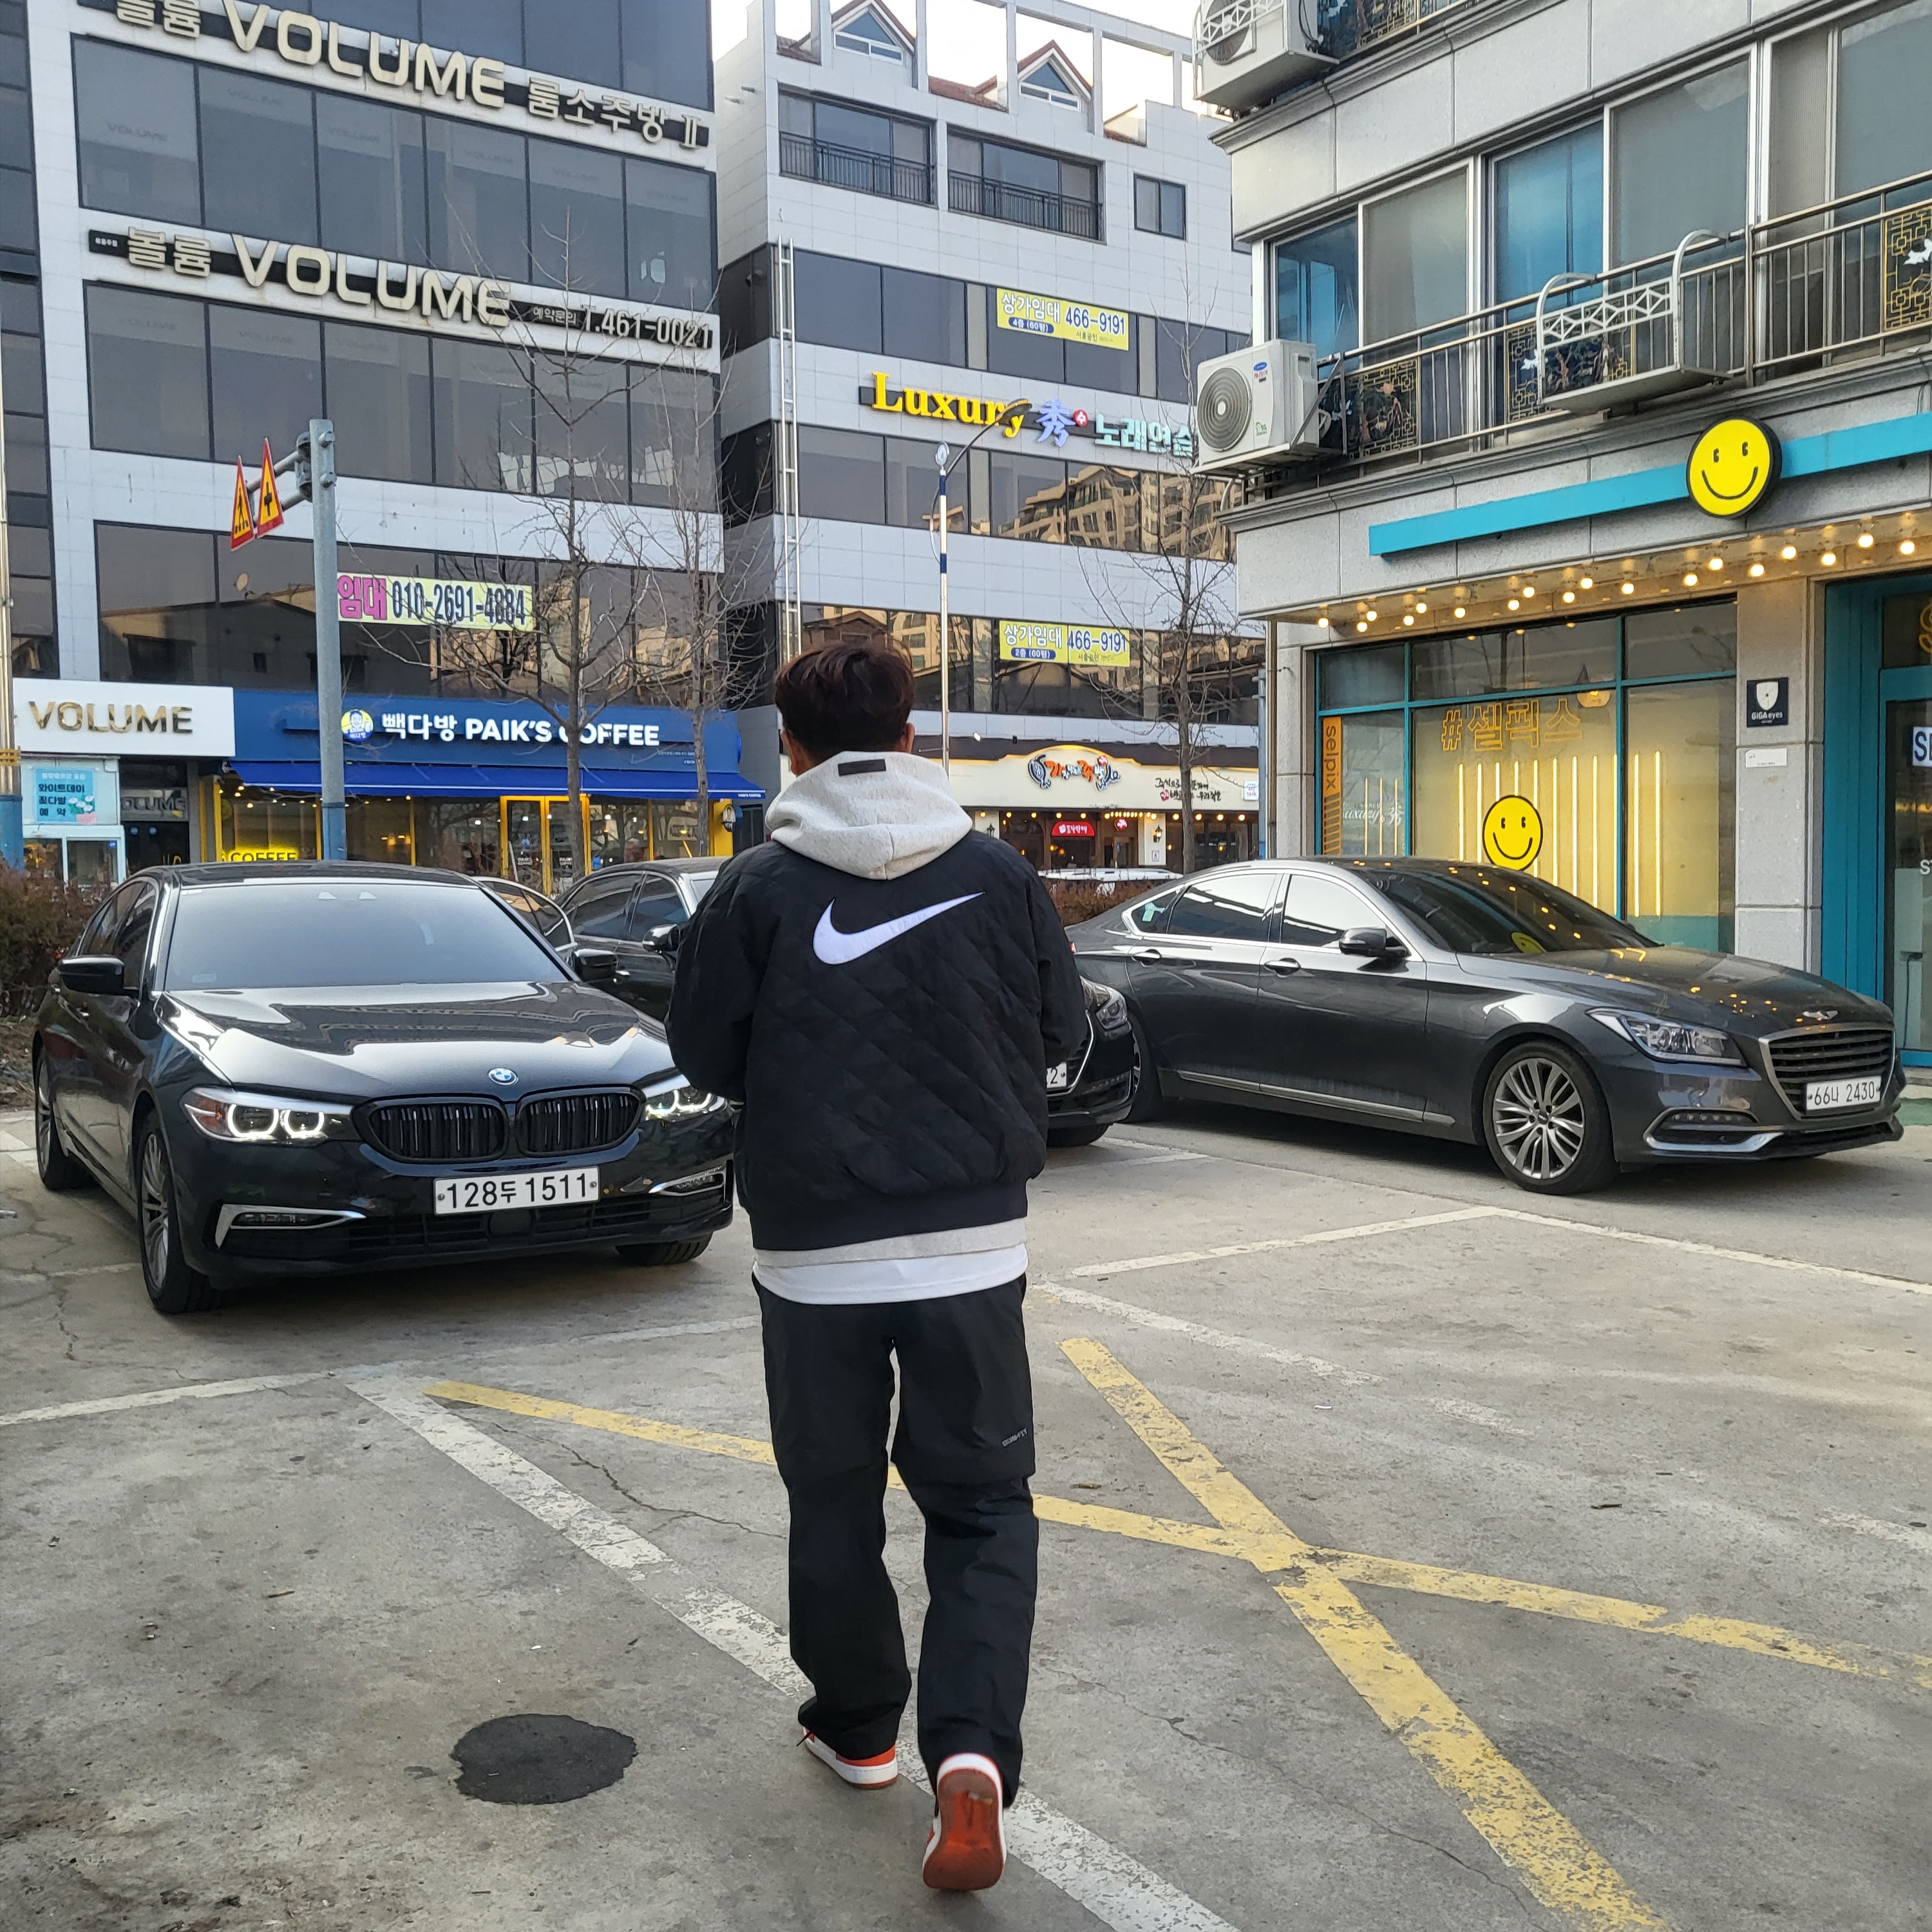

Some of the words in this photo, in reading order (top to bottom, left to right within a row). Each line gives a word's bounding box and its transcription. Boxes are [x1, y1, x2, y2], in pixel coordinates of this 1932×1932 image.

[222, 0, 505, 108] VOLUME
[528, 77, 668, 143] 룸소주방
[128, 226, 211, 278] 볼륨
[231, 233, 511, 327] VOLUME
[532, 306, 577, 325] 예약문의
[1001, 292, 1061, 324] 상가임대
[1065, 305, 1125, 336] 466-9191
[872, 371, 1026, 439] Luxury
[1036, 398, 1076, 448] 秀
[337, 575, 388, 621] 임대
[392, 580, 527, 626] 010-2691-4884
[1004, 624, 1063, 649] 상가임대
[1066, 629, 1126, 652] 466-9191
[28, 701, 193, 734] VOLUME
[381, 713, 458, 742] 빽다방
[465, 717, 553, 742] PAIK'S
[558, 723, 659, 746] COFFEE
[1441, 698, 1582, 752] #셀픽스
[1324, 725, 1340, 791] selpix
[1920, 858, 1932, 875] S
[1046, 1068, 1058, 1085] 2
[1846, 1081, 1875, 1103] 2430
[447, 1180, 517, 1209] 128두
[525, 1173, 586, 1202] 1511
